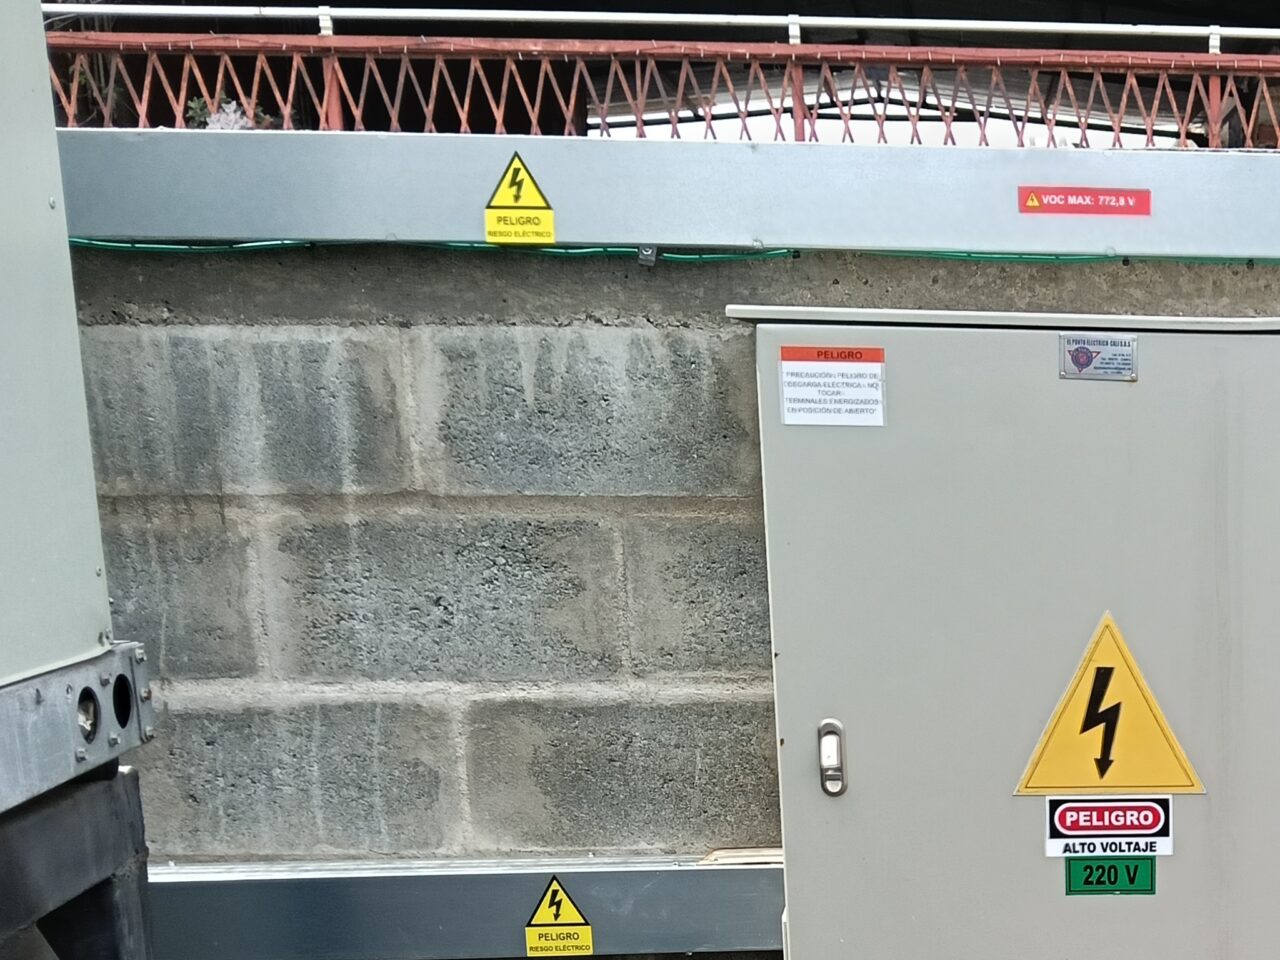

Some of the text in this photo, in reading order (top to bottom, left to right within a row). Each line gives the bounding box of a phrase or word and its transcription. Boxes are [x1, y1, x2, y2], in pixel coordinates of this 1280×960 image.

[1041, 195, 1136, 207] VOC MAX: 772,8 V
[496, 216, 541, 226] PELIGRO
[816, 350, 863, 360] PELIGRO
[1065, 810, 1154, 827] PELIGRO
[1062, 841, 1157, 854] ALTO VOLTAJE
[1083, 864, 1139, 886] 220 V
[538, 932, 580, 941] PELIGRO
[555, 944, 591, 952] ELÉCTRICO
